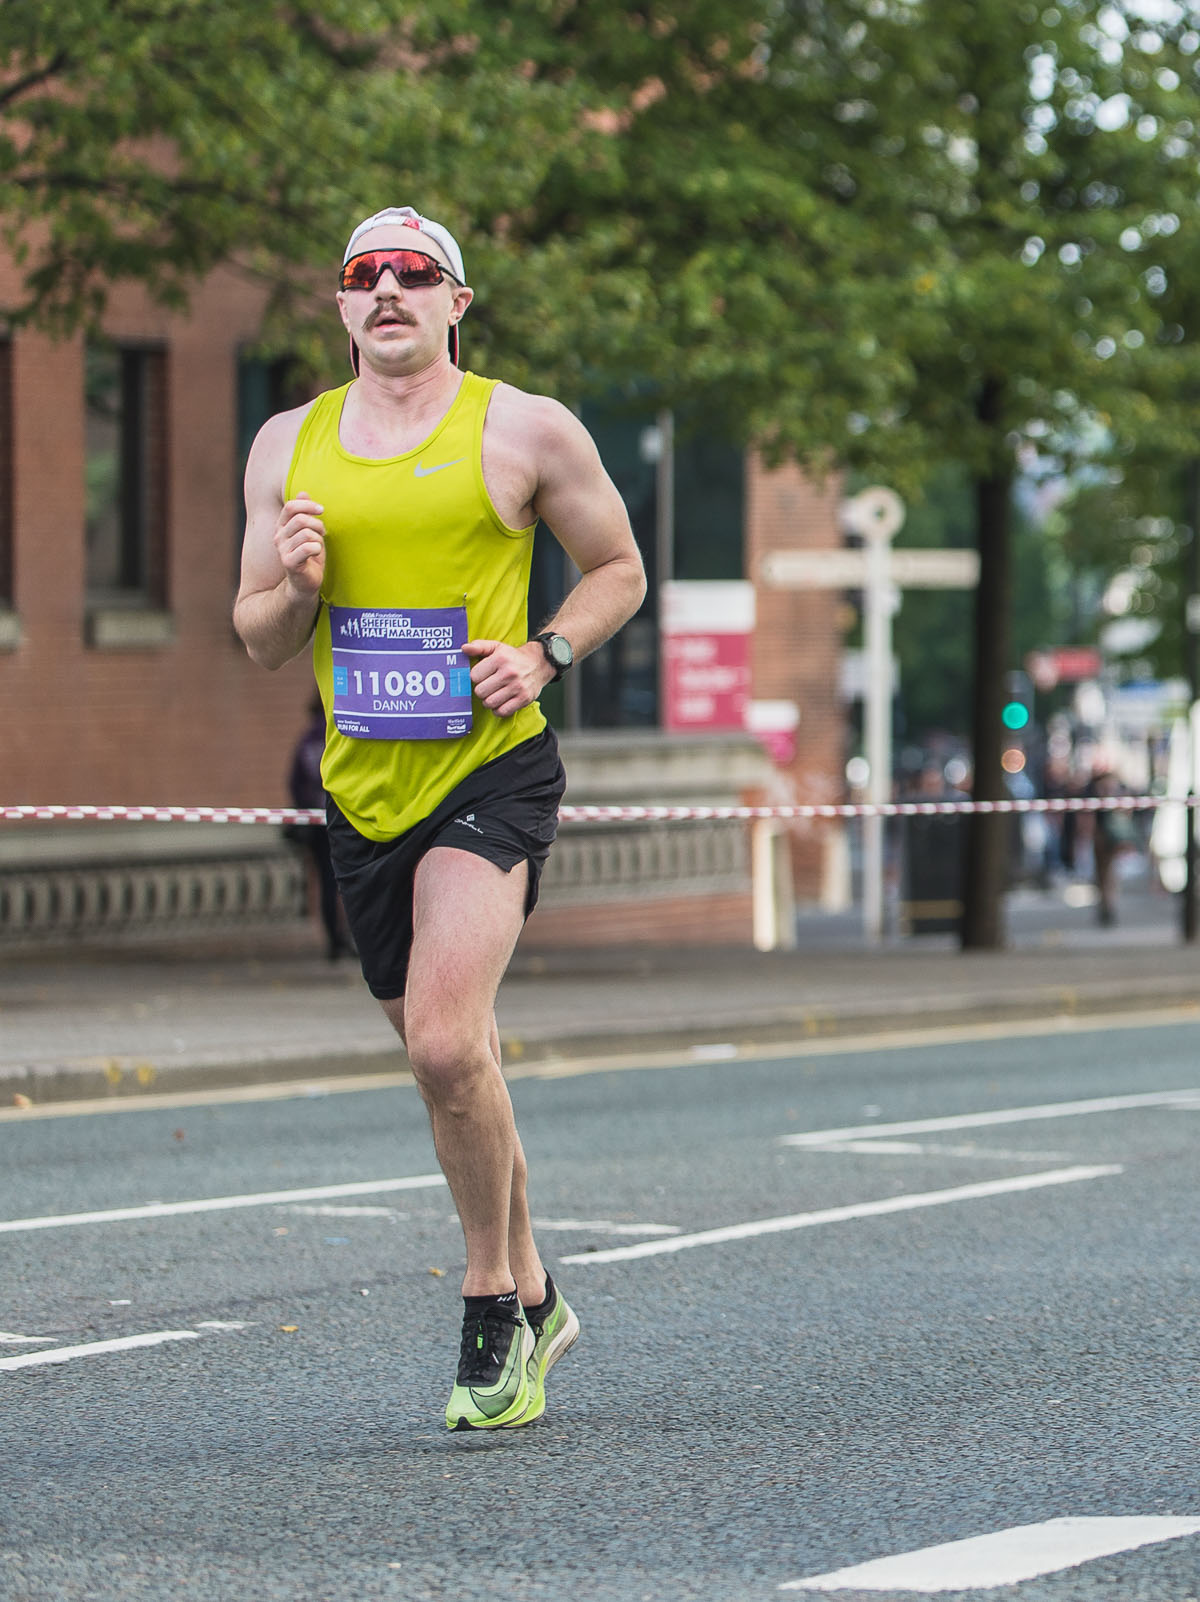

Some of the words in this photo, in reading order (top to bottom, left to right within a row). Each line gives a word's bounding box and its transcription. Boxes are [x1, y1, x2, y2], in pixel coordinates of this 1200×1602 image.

[362, 619, 409, 628] SHEFFIELD
[362, 628, 387, 638] HALF
[388, 627, 451, 637] MARATHON
[422, 638, 453, 649] 2020
[446, 655, 457, 665] M
[353, 670, 446, 697] 11080
[373, 699, 417, 711] DANNY
[359, 725, 370, 733] ALL
